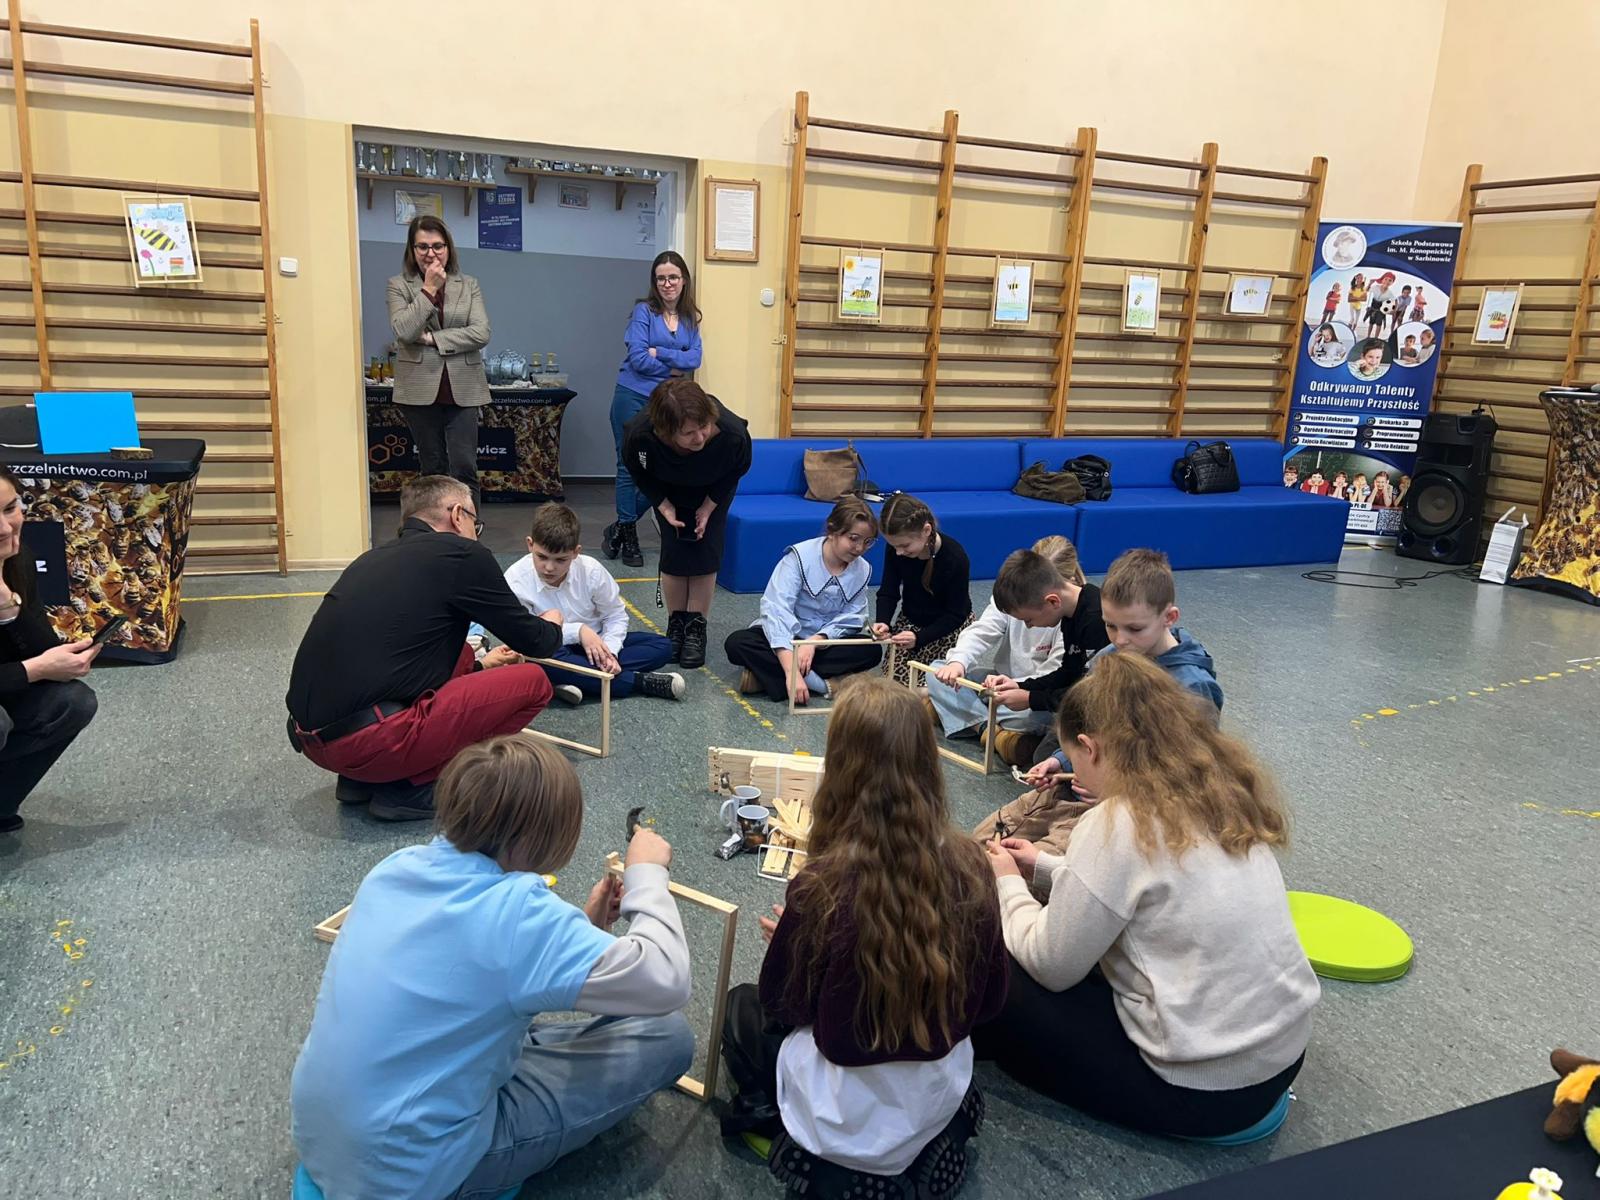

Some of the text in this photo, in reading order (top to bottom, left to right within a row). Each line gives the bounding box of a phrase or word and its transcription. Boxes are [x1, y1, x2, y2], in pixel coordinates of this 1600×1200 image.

[1413, 240, 1454, 248] Podstawowa
[1409, 247, 1452, 257] Konopnickiej
[1310, 380, 1415, 397] Odkrywamy Talenty
